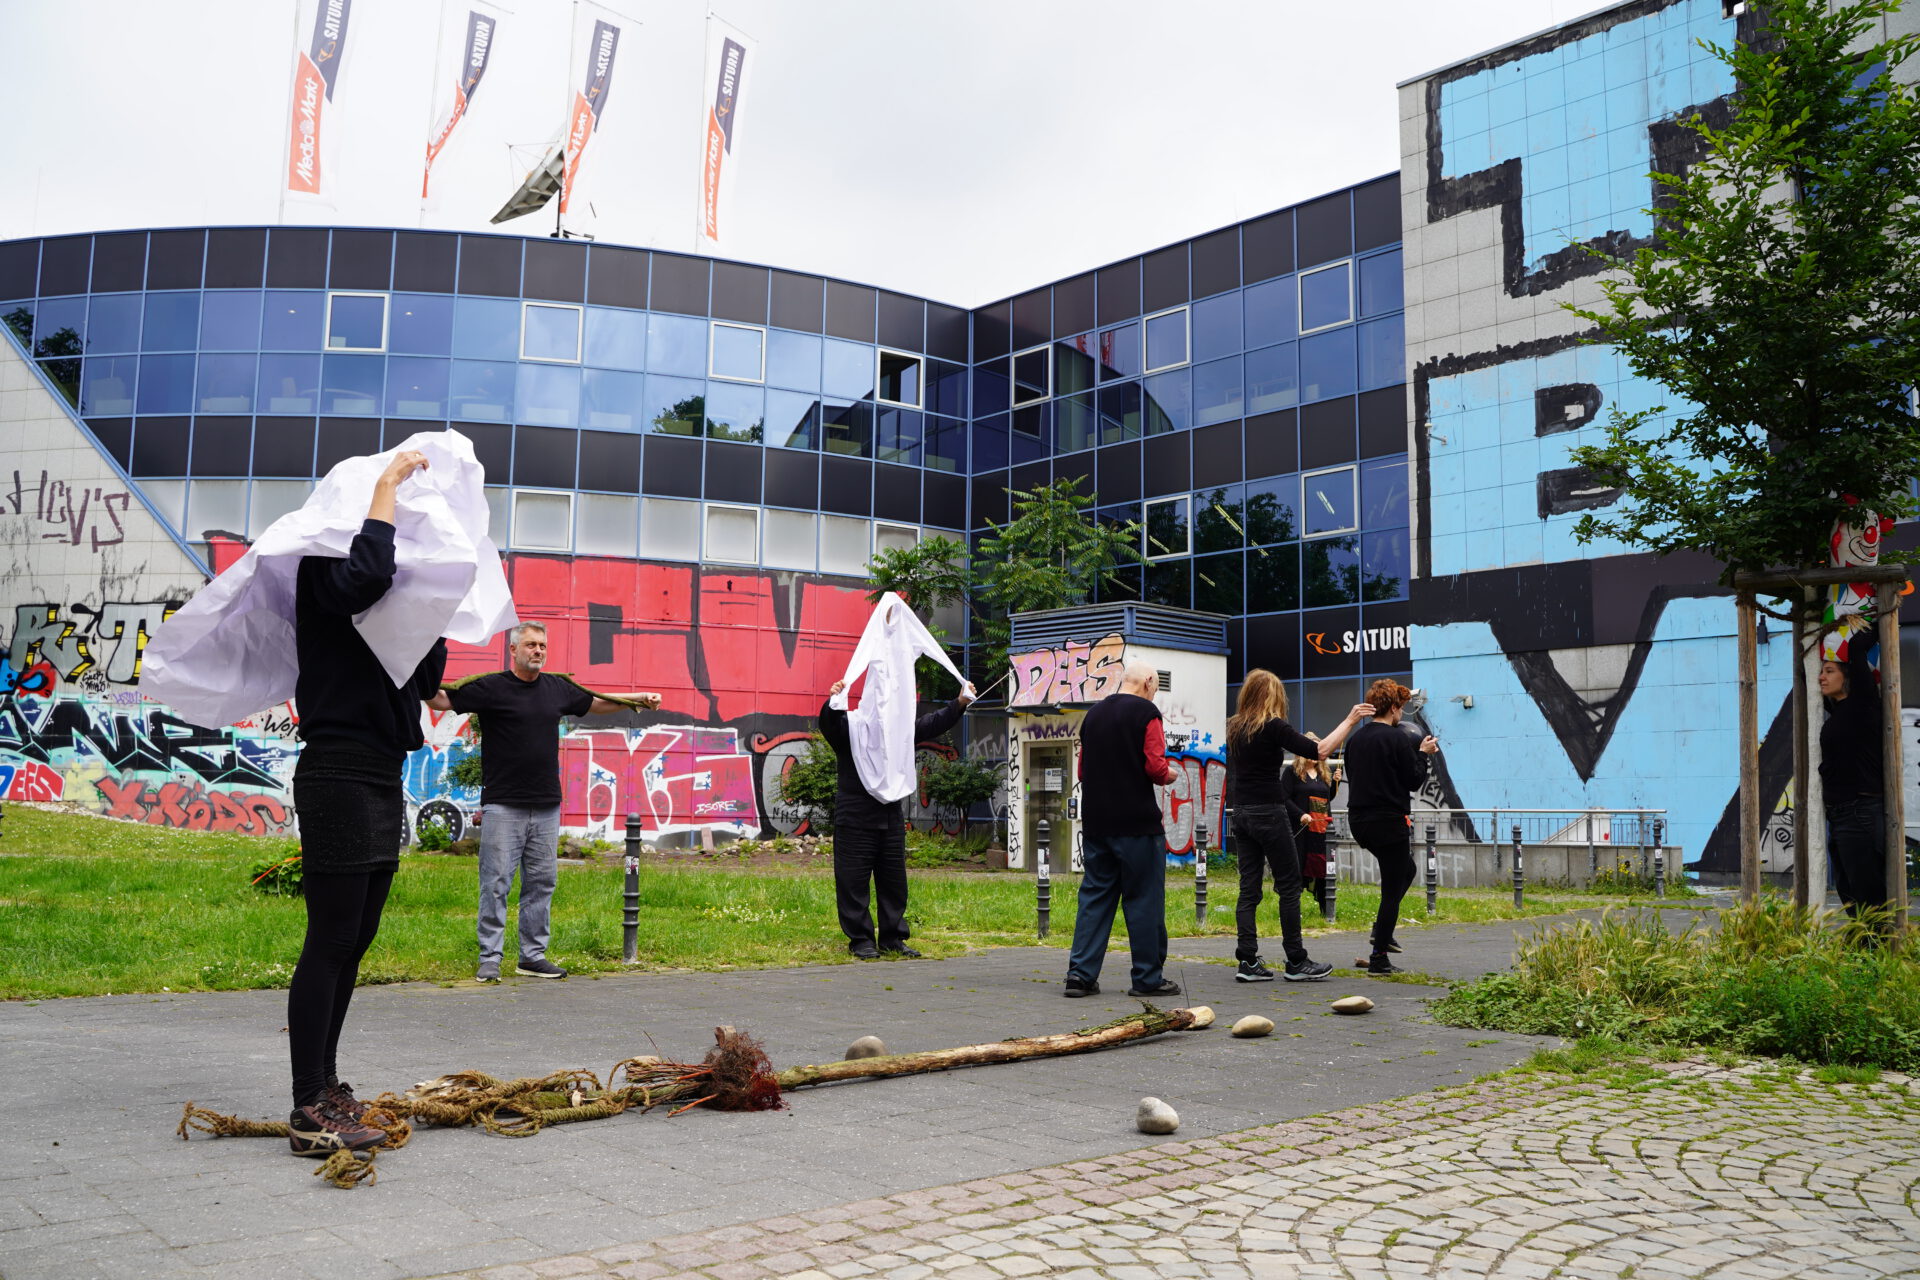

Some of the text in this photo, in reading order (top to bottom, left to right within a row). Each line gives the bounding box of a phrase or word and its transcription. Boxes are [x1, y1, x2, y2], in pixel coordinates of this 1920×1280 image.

[323, 0, 344, 40] SATUR
[471, 20, 490, 68] SATURN
[596, 29, 614, 78] SATURN
[722, 48, 740, 96] SATURN
[296, 76, 319, 186] Media Markt
